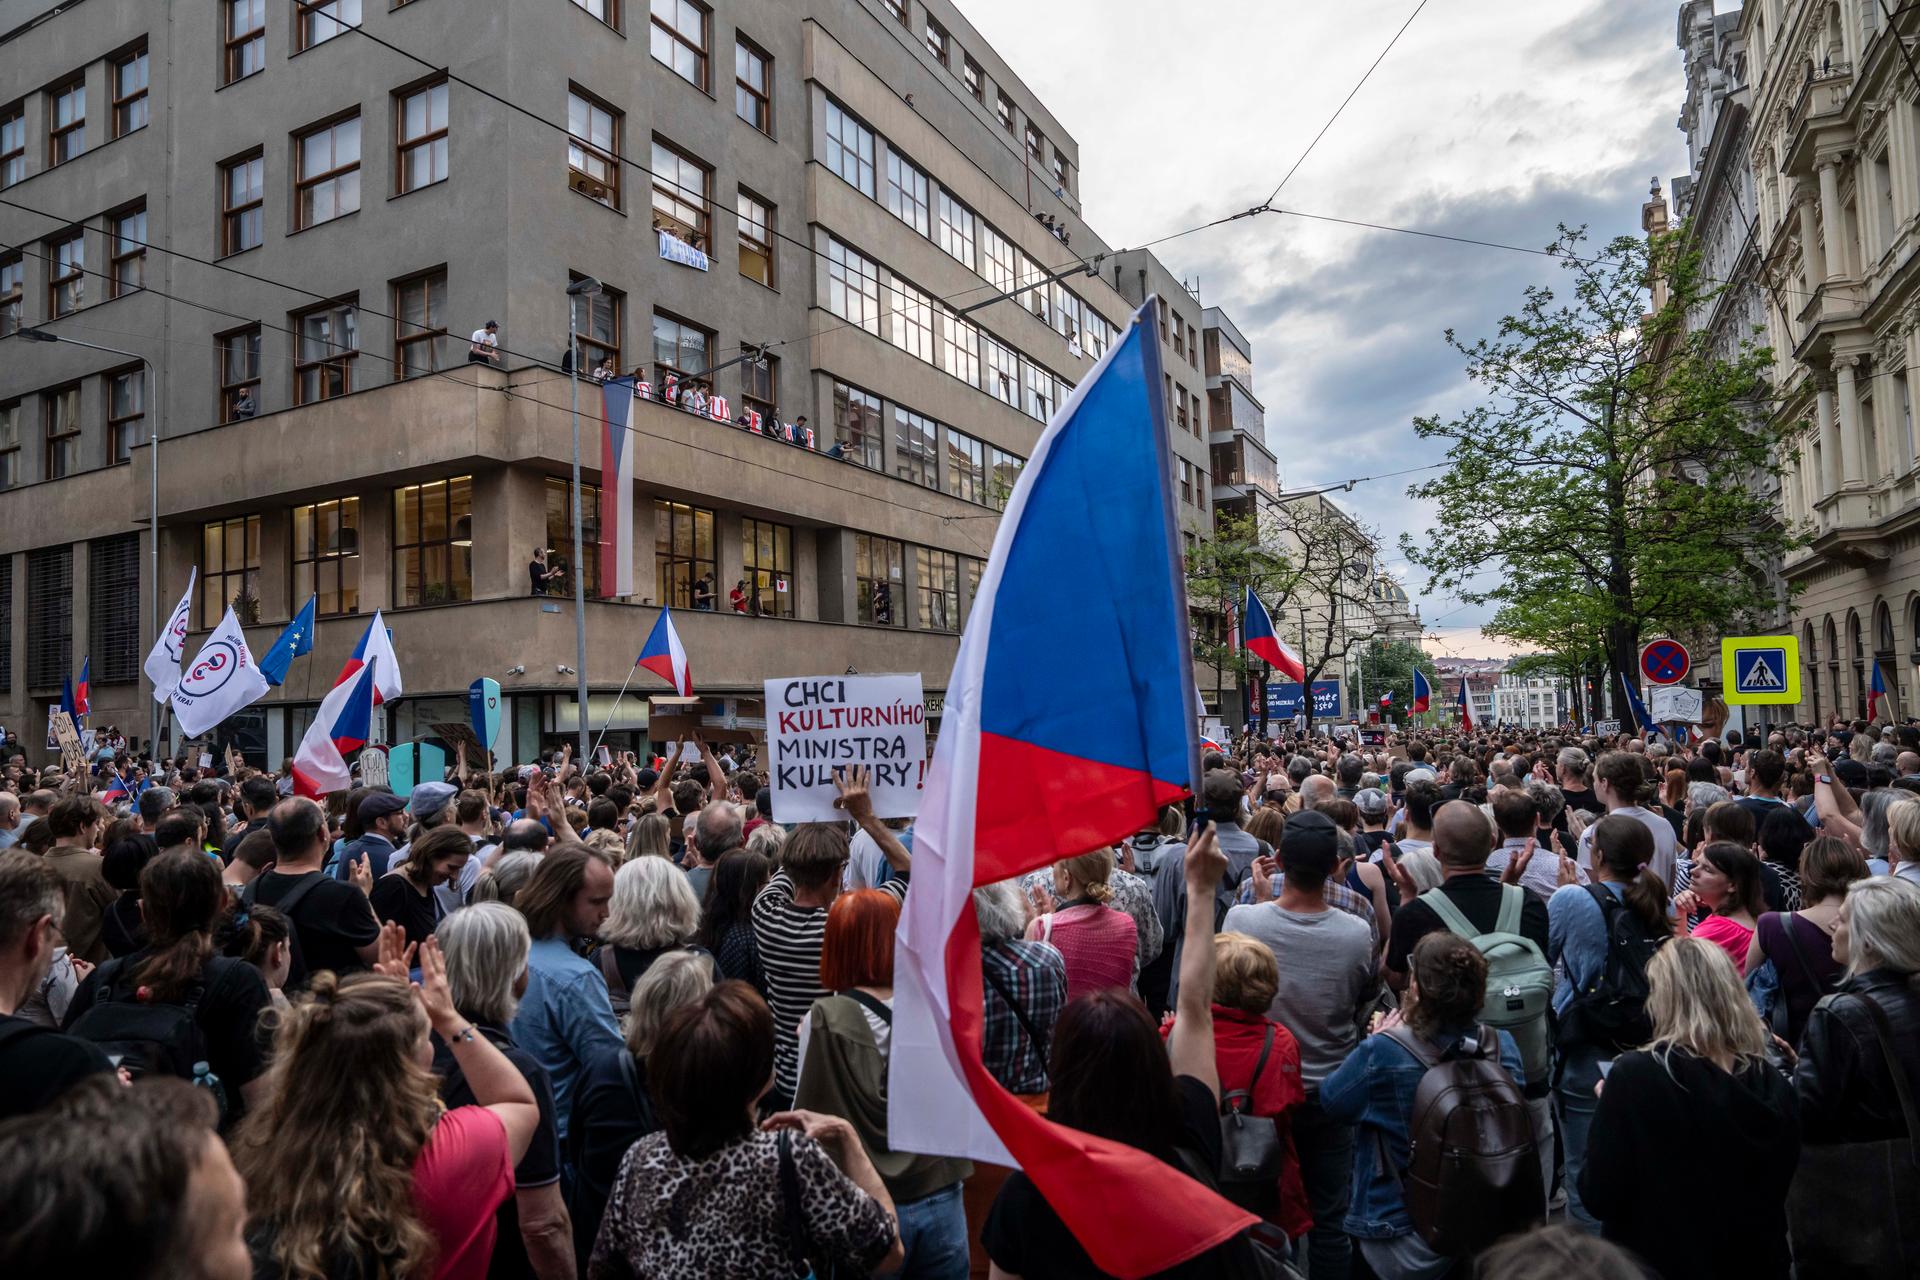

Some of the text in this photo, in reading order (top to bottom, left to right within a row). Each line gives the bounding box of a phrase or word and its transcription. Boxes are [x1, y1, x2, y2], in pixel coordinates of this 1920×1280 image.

[784, 681, 845, 707] CHCI
[778, 698, 924, 734] KULTURNÍHO
[778, 735, 906, 760] MINISTRA
